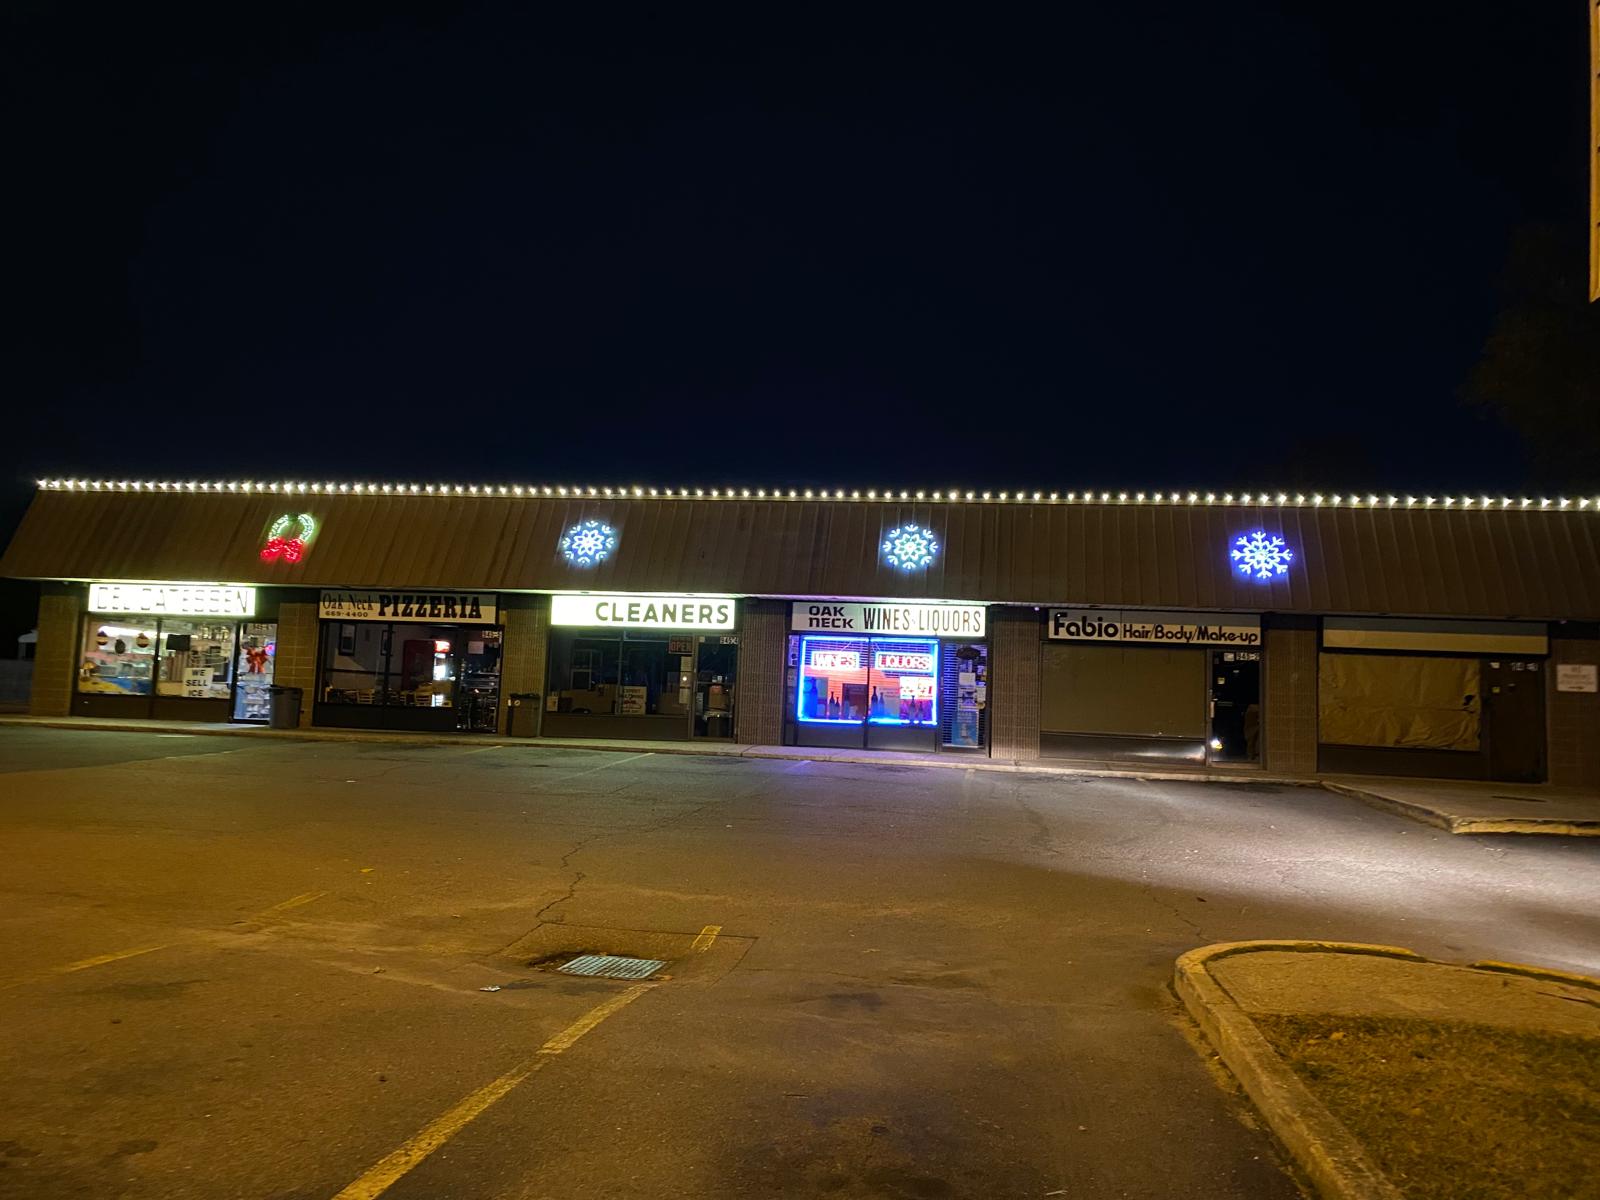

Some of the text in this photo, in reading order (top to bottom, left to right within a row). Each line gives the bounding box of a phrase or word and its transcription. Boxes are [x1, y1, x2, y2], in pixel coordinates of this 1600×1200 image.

[97, 586, 248, 614] DECAESSEN
[322, 592, 374, 611] Oak Neck
[378, 594, 482, 619] PIZZERIA
[595, 602, 729, 624] CLEANERS
[808, 605, 845, 617] OAK
[808, 617, 854, 629] NECK
[863, 608, 980, 634] WINES LIQUORS
[1053, 611, 1118, 638] Fabio
[813, 652, 856, 667] WINES
[879, 653, 930, 669] LIQUORS
[192, 669, 205, 677] WE
[185, 679, 208, 687] SELL
[189, 689, 204, 697] ICE
